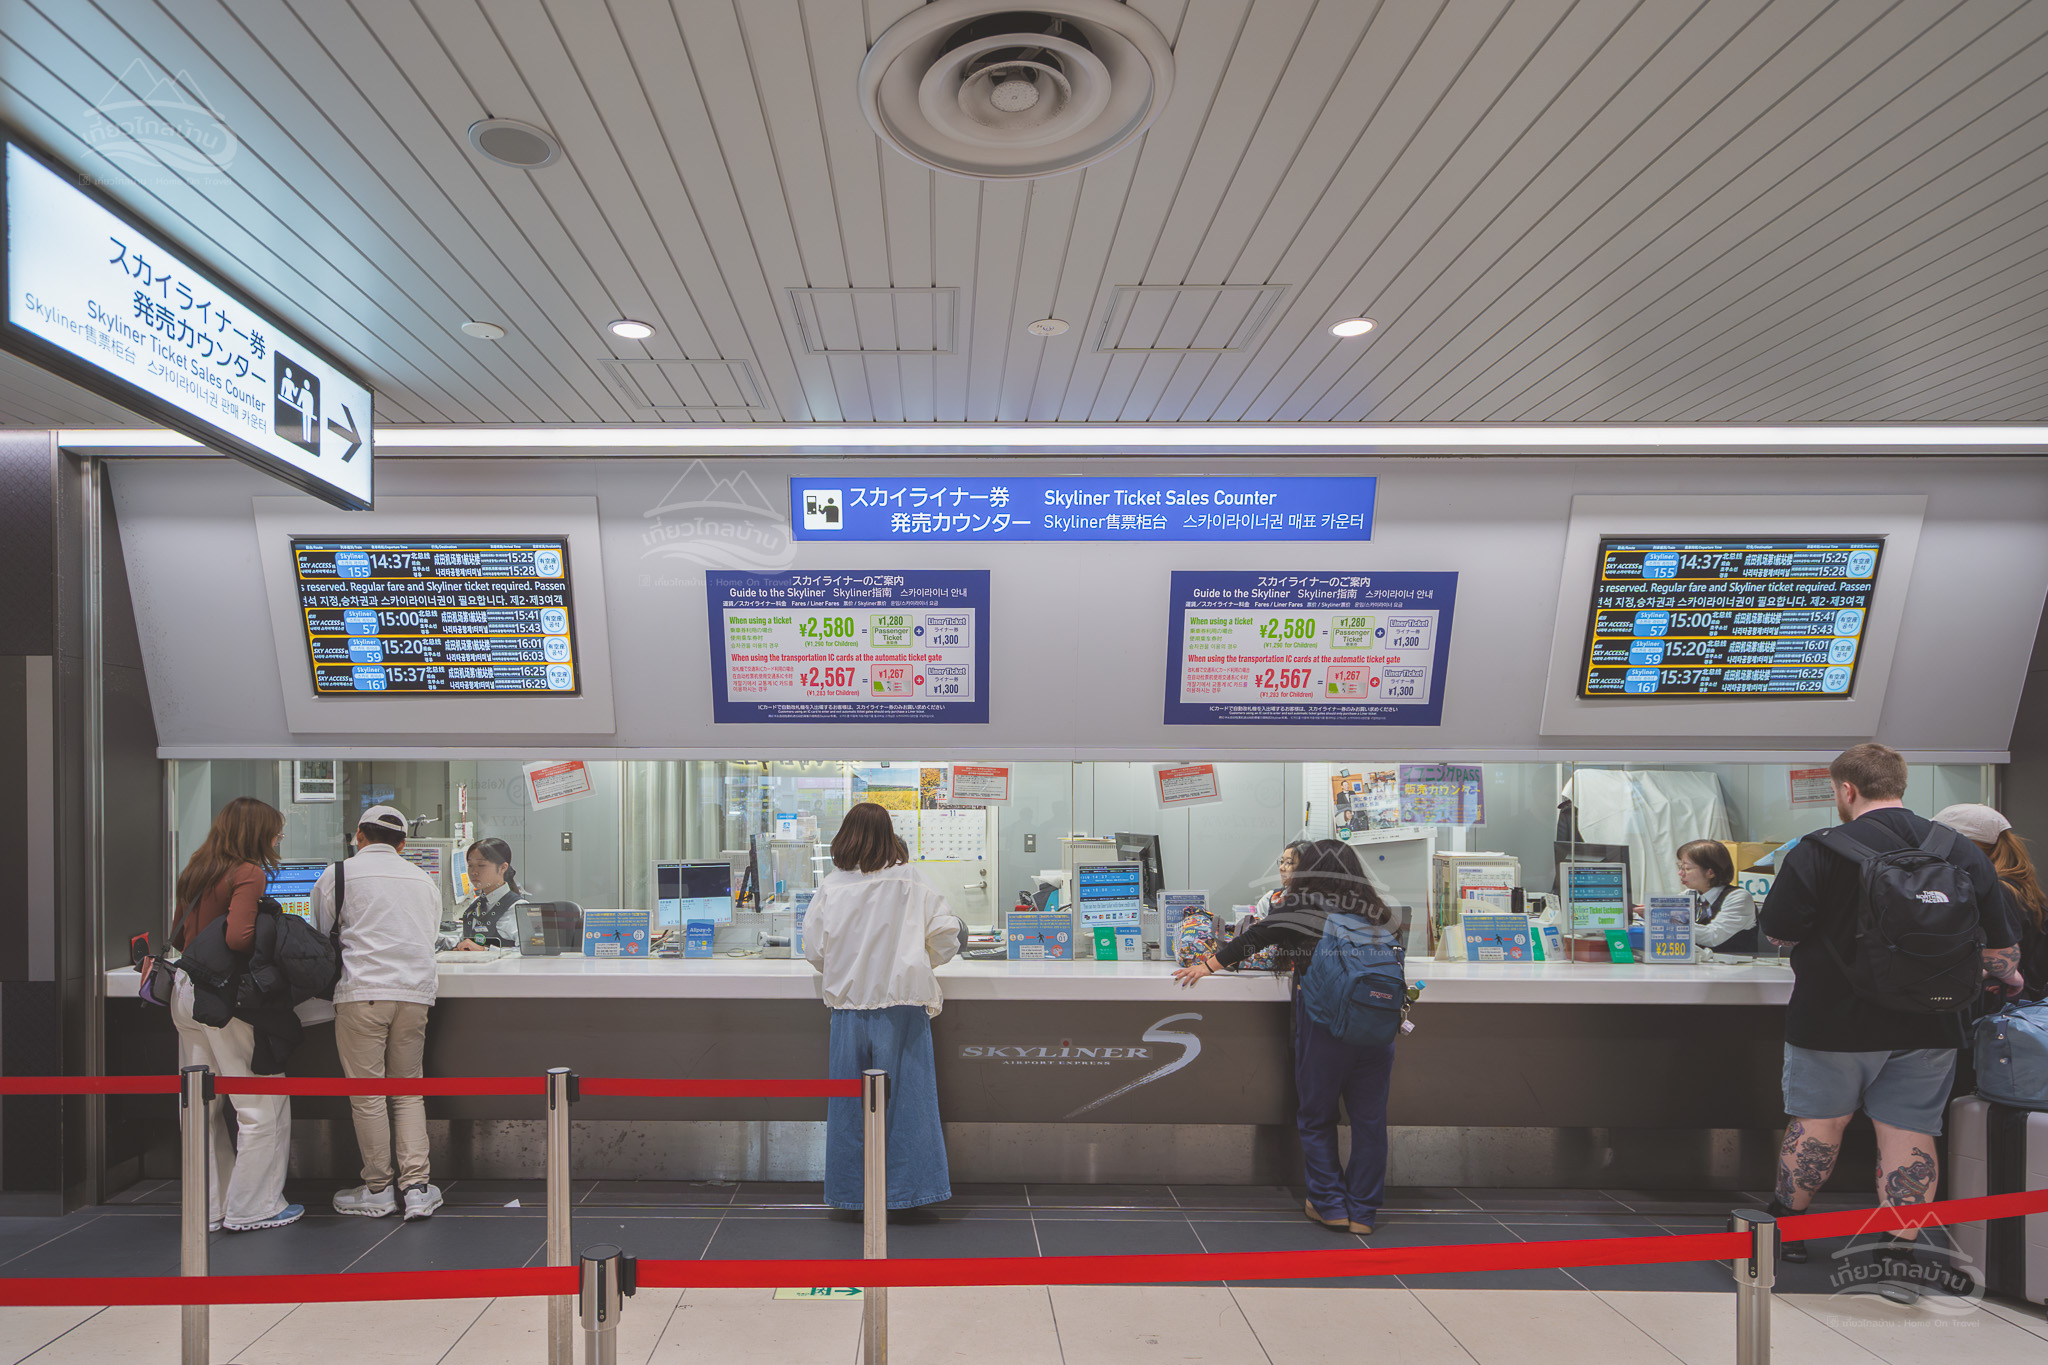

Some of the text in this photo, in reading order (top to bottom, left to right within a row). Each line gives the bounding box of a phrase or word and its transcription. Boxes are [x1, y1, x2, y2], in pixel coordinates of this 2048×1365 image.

[109, 236, 266, 361] スカイライナー券
[133, 290, 266, 383] 発売カウンター
[87, 300, 266, 413] Skyliner Ticket Sales Counter
[147, 359, 267, 435] 스카이라이너권 판매 카운터
[850, 486, 1010, 508] スカイライナー券
[1043, 489, 1277, 508] Skyliner Ticket Sales Counter
[891, 512, 1031, 534] 発売カウンター
[1182, 513, 1364, 530] 스카이라이너권 매표 카운터
[340, 553, 364, 561] Skyliner
[370, 554, 411, 569] 14:37
[507, 553, 533, 563] 15:25
[1680, 554, 1723, 570] 14:37
[1820, 553, 1848, 563] 15:25
[348, 567, 369, 578] 155
[509, 566, 535, 576] 15:28
[1653, 567, 1675, 578] 155
[1818, 566, 1846, 576] 15:28
[306, 583, 349, 592] reserved.
[350, 582, 385, 593] Regular
[386, 582, 405, 592] fare
[406, 582, 424, 592] and
[426, 581, 462, 593] Skyliner
[464, 581, 490, 592] ticket
[491, 581, 533, 593] required.
[534, 581, 566, 591] Passen
[792, 575, 904, 587] スカイライナーのご案内
[1257, 576, 1371, 588] スカイライナーのご案内
[729, 588, 826, 600] Guide to the Skyliner
[900, 587, 968, 598] 스카이라이너 안내
[1193, 588, 1291, 600] Guide to the Skyliner
[378, 611, 419, 627] 15:00
[514, 610, 539, 620] 15:41
[729, 616, 748, 625] When
[748, 616, 767, 626] using
[773, 616, 792, 625] ticket
[1670, 612, 1712, 628] 15:00
[1810, 611, 1836, 622] 15:41
[878, 616, 904, 628] ¥1,280
[927, 617, 967, 626] Liner Ticket
[1340, 617, 1366, 629] ¥1,280
[362, 624, 377, 635] 57
[514, 623, 540, 633] 15:43
[799, 617, 855, 641] ¥2,580
[874, 627, 909, 637] Passenger
[1259, 618, 1316, 642] ¥2,580
[1650, 625, 1666, 636] 57
[1806, 624, 1833, 635] 15:43
[517, 639, 542, 649] 16:01
[825, 640, 833, 648] for
[834, 640, 859, 648] Children)
[933, 634, 959, 647] ¥1,300
[382, 639, 423, 655] 15:20
[366, 652, 382, 663] 59
[518, 651, 544, 661] 16:03
[731, 653, 943, 664] When using the transportation IC cards at the automatic ticket gate
[386, 667, 426, 682] 15:37
[520, 666, 546, 677] 16:25
[878, 668, 904, 680] ¥1,267
[1335, 670, 1361, 681] ¥1,267
[521, 679, 547, 689] 16:29
[800, 666, 856, 690] ¥2,567
[1255, 668, 1312, 692] ¥2,567
[366, 680, 385, 690] 161
[933, 684, 959, 695] ¥1,300
[1404, 783, 1481, 796] 販売カウンター
[1656, 942, 1686, 957] ¥2,580
